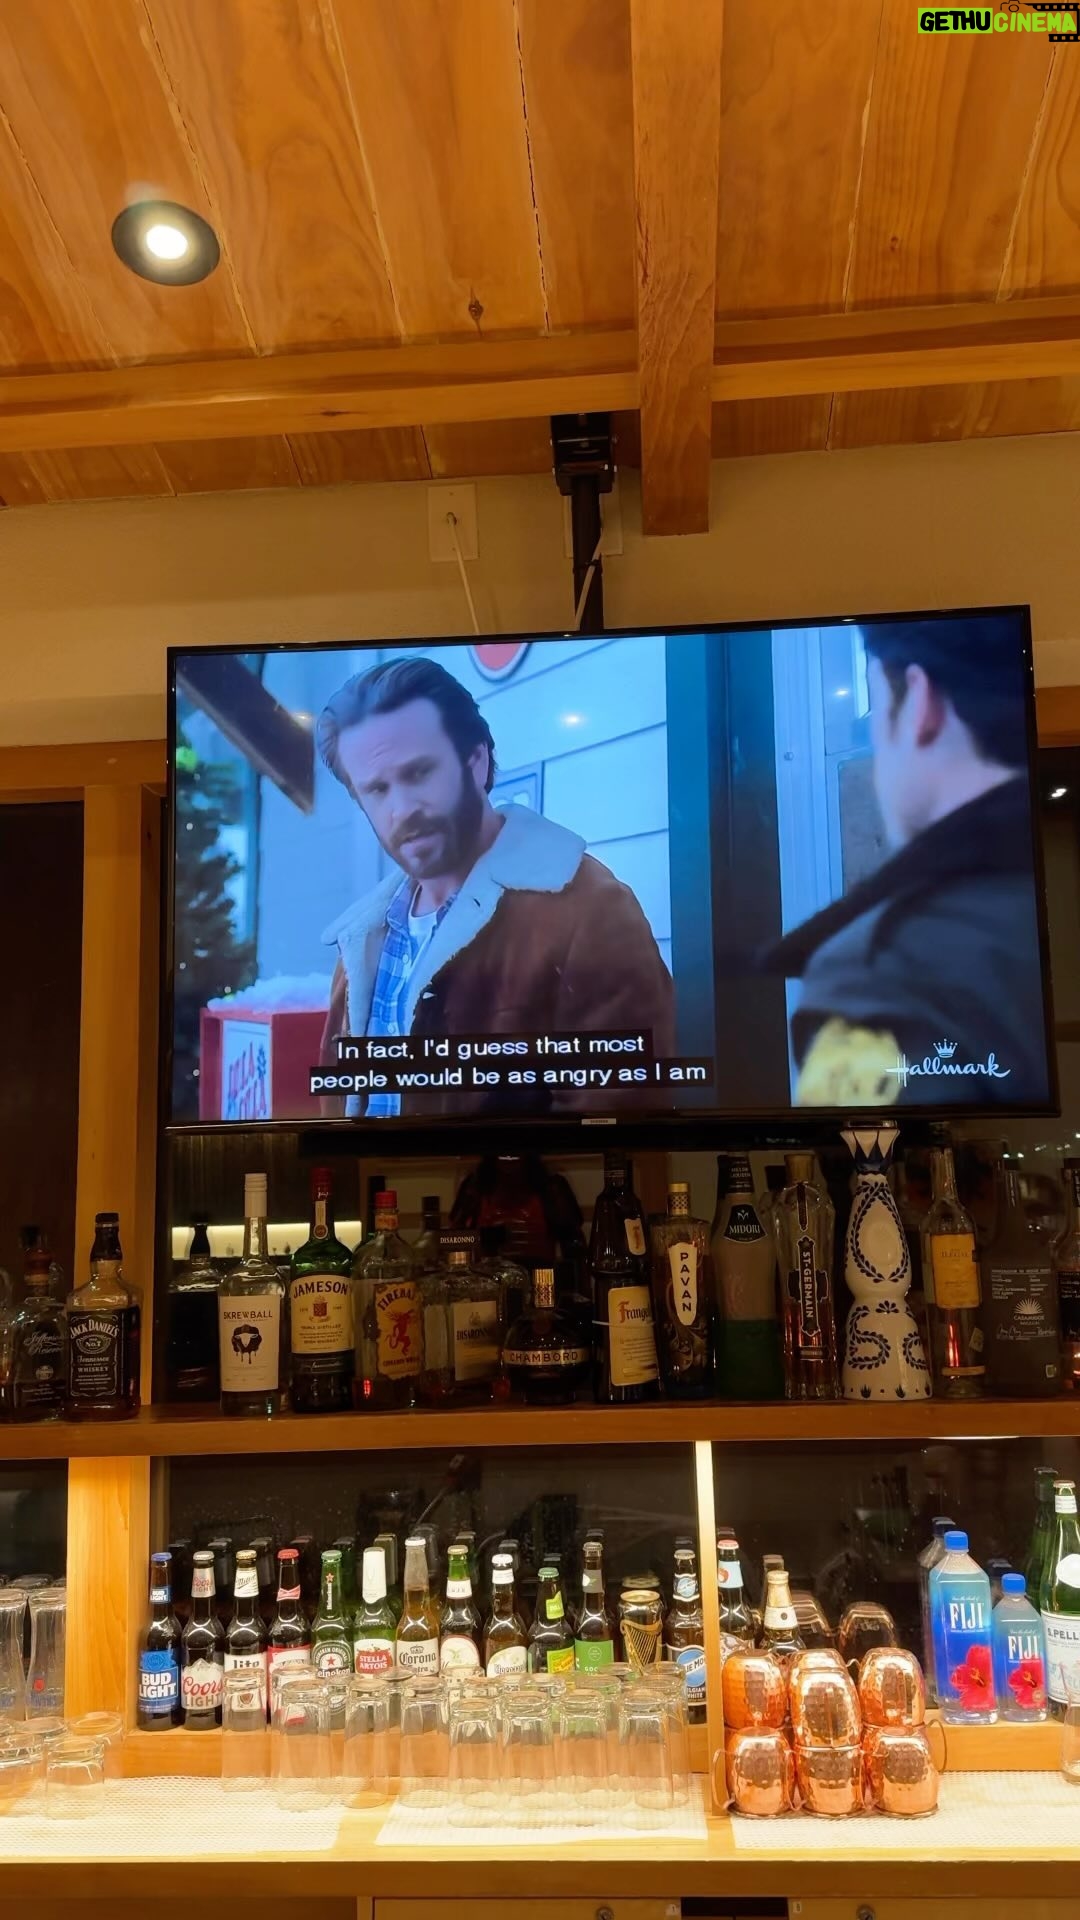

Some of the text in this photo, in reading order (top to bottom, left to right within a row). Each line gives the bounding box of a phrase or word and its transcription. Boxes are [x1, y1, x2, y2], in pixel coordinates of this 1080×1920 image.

[337, 1035, 645, 1060] In fact, I'd guess that most
[310, 1063, 707, 1093] people would be as angry as I am
[885, 1052, 1011, 1088] Hallmark
[729, 1224, 761, 1235] MIDORI
[440, 1235, 475, 1244] DISARONNO
[293, 1280, 349, 1299] JAMESON
[679, 1252, 692, 1312] PAVAN
[802, 1251, 814, 1319] ST-GERMAIN
[223, 1309, 273, 1320] SKREWBALL
[70, 1319, 120, 1340] JACK DANIEL'S
[510, 1351, 579, 1363] CHAMBORD
[949, 1602, 984, 1629] FIJI
[1007, 1635, 1039, 1660] FIJI
[359, 1655, 388, 1663] STELLA
[359, 1661, 388, 1670] ARTOIS
[399, 1651, 437, 1666] Corona
[142, 1672, 172, 1686] BUD
[317, 1667, 350, 1678] eineken
[139, 1682, 177, 1699] LIGHT
[182, 1676, 224, 1697] Coors
[185, 1693, 222, 1707] LIGHT
